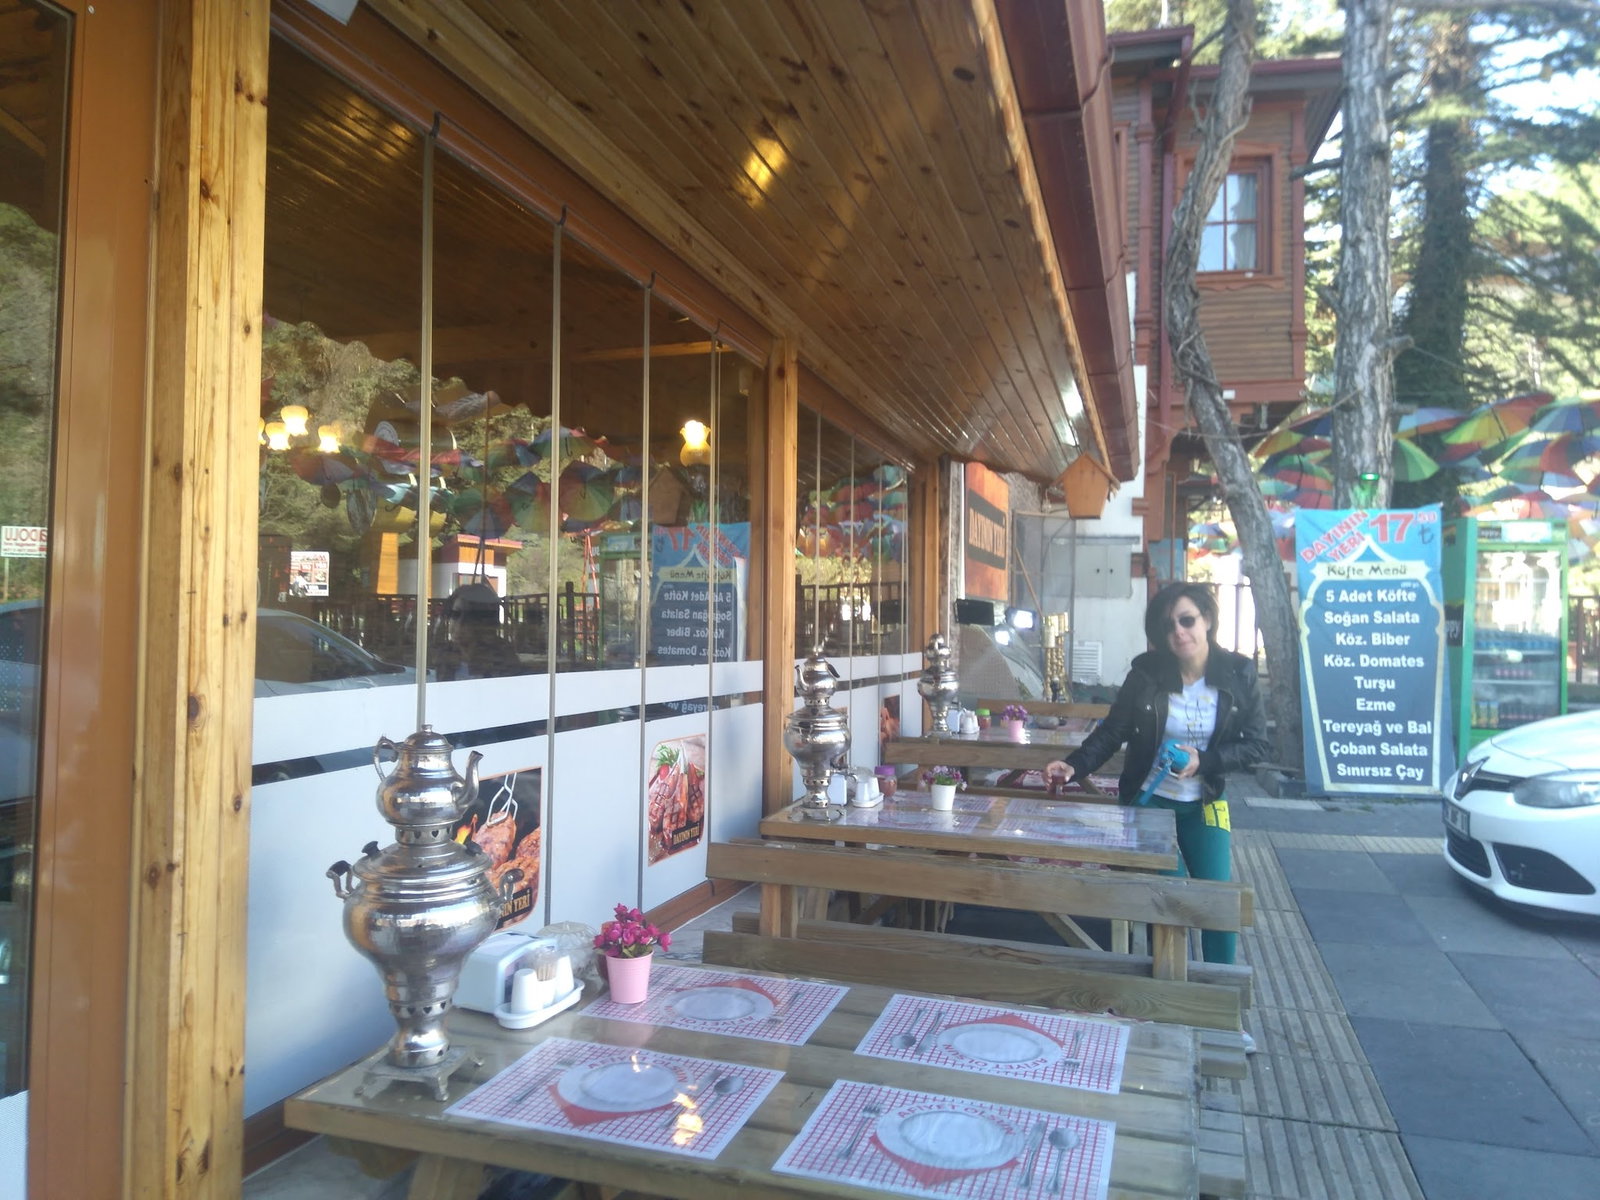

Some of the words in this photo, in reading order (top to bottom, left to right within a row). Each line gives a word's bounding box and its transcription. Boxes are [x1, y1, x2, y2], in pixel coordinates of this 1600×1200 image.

[1300, 510, 1369, 563] DAYININ
[1327, 530, 1366, 562] YERİ
[1327, 564, 1363, 579] Köfte
[1368, 564, 1407, 576] Menü
[1325, 589, 1335, 603] 5
[1339, 589, 1373, 603] Adet
[1377, 588, 1417, 603] Köfte
[1324, 611, 1369, 627] Soğan
[1373, 610, 1420, 625] Salata
[1335, 632, 1367, 646] Köz.
[1371, 632, 1410, 646] Biber
[1323, 654, 1356, 667] Köz.
[1359, 654, 1425, 668] Domates
[1354, 676, 1396, 692] Turşu
[1356, 698, 1396, 712] Ezme
[1323, 719, 1382, 736] Tereyağ
[1386, 722, 1403, 733] ve
[1407, 720, 1432, 734] Bal
[1329, 742, 1376, 758] Çoban
[1380, 743, 1428, 757] Salata
[1336, 763, 1392, 777] Sınırsız
[1396, 764, 1424, 781] Çay
